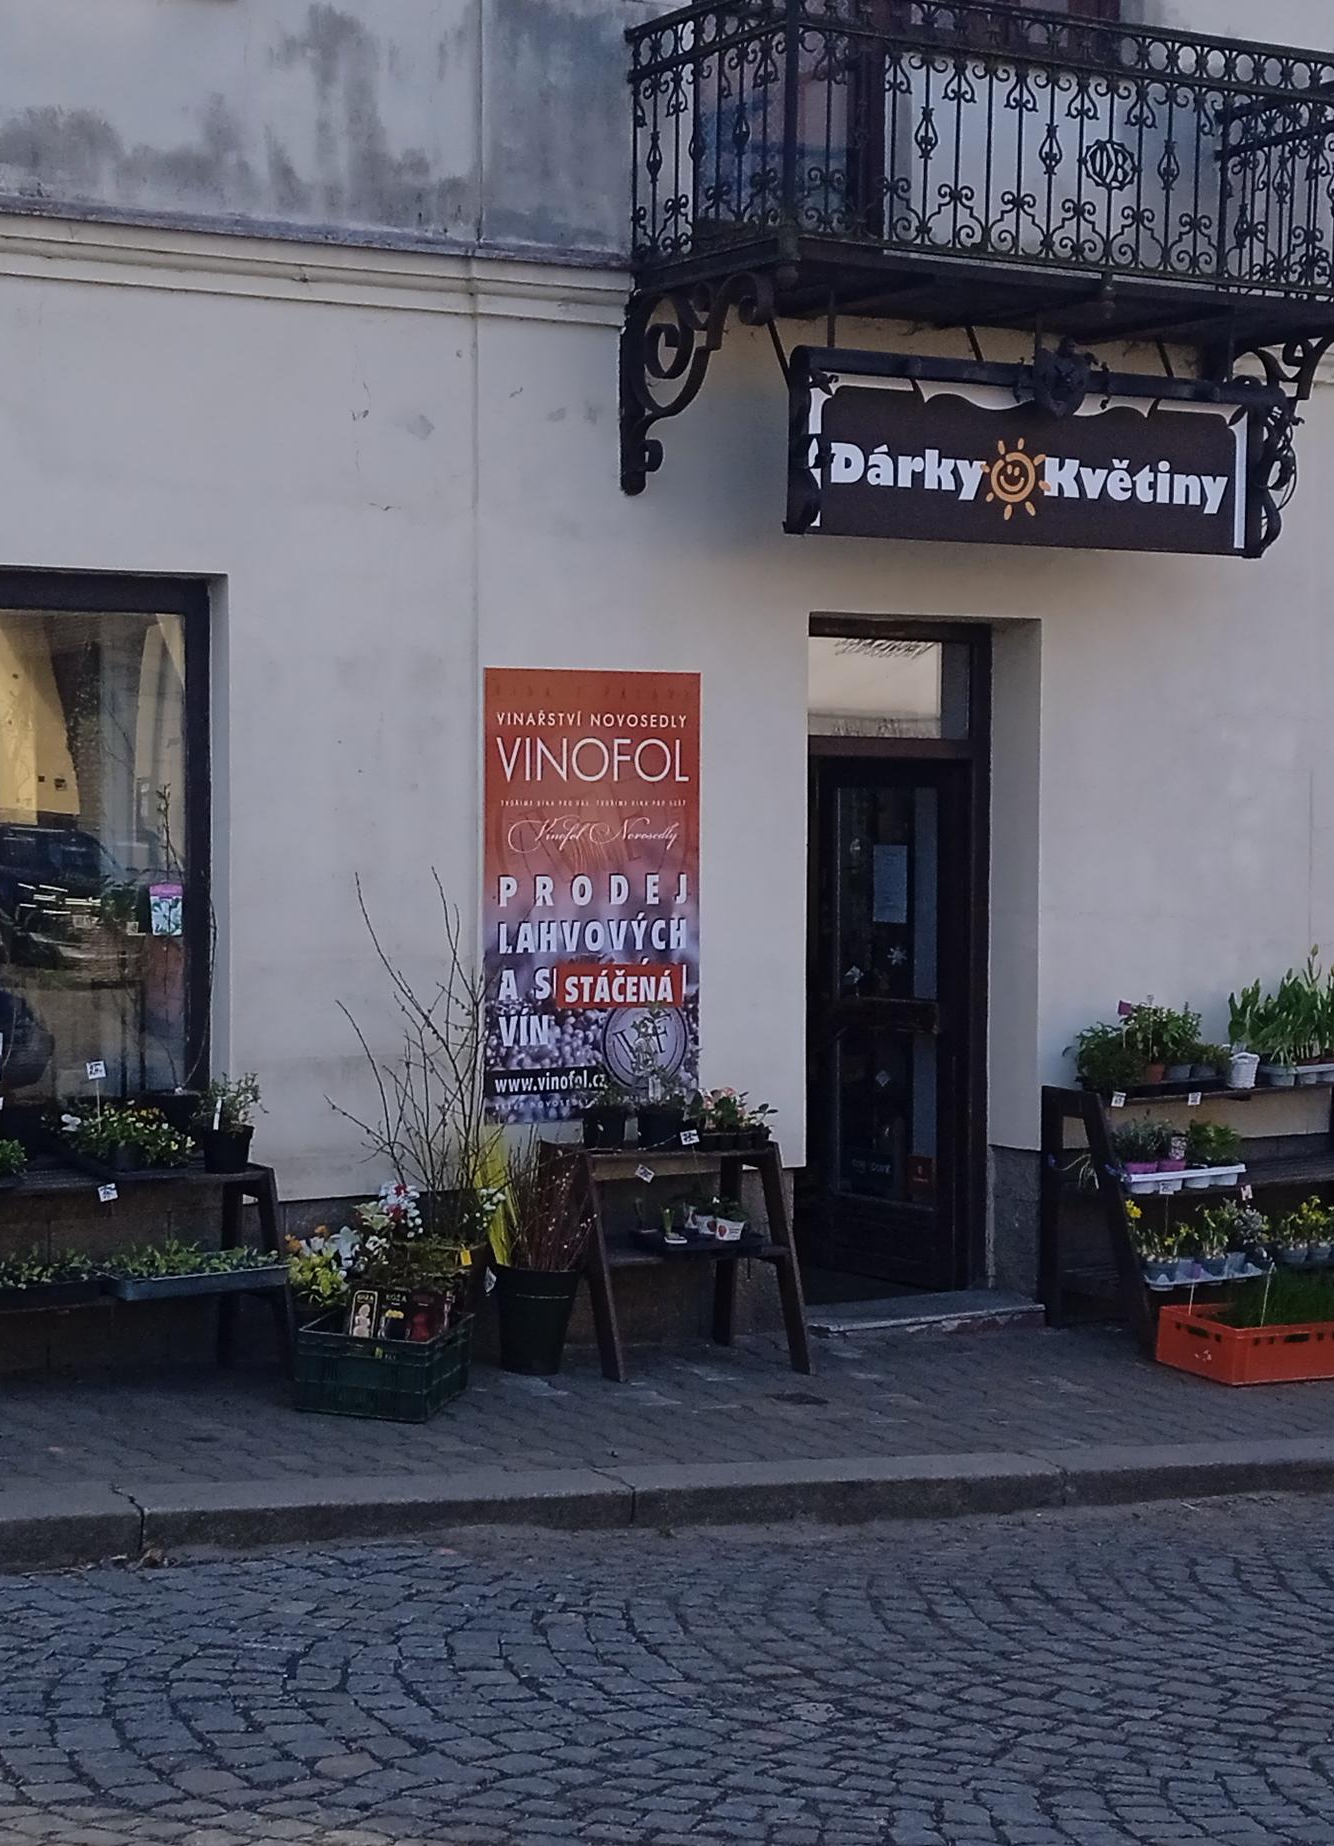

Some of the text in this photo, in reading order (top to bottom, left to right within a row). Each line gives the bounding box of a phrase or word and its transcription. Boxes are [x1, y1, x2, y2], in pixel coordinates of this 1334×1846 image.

[829, 442, 1229, 515] Dárky Květiny
[496, 709, 687, 729] VINAŘSTVÍ NOVOSEDLY
[496, 737, 690, 782] VINOFOL
[590, 816, 679, 850] Novosedly
[498, 874, 688, 907] PRODEJ
[498, 912, 687, 954] LAHVOVÝCH
[499, 968, 518, 1000] A
[565, 968, 673, 1003] STÁČENÁ
[499, 1008, 550, 1047] VÍN
